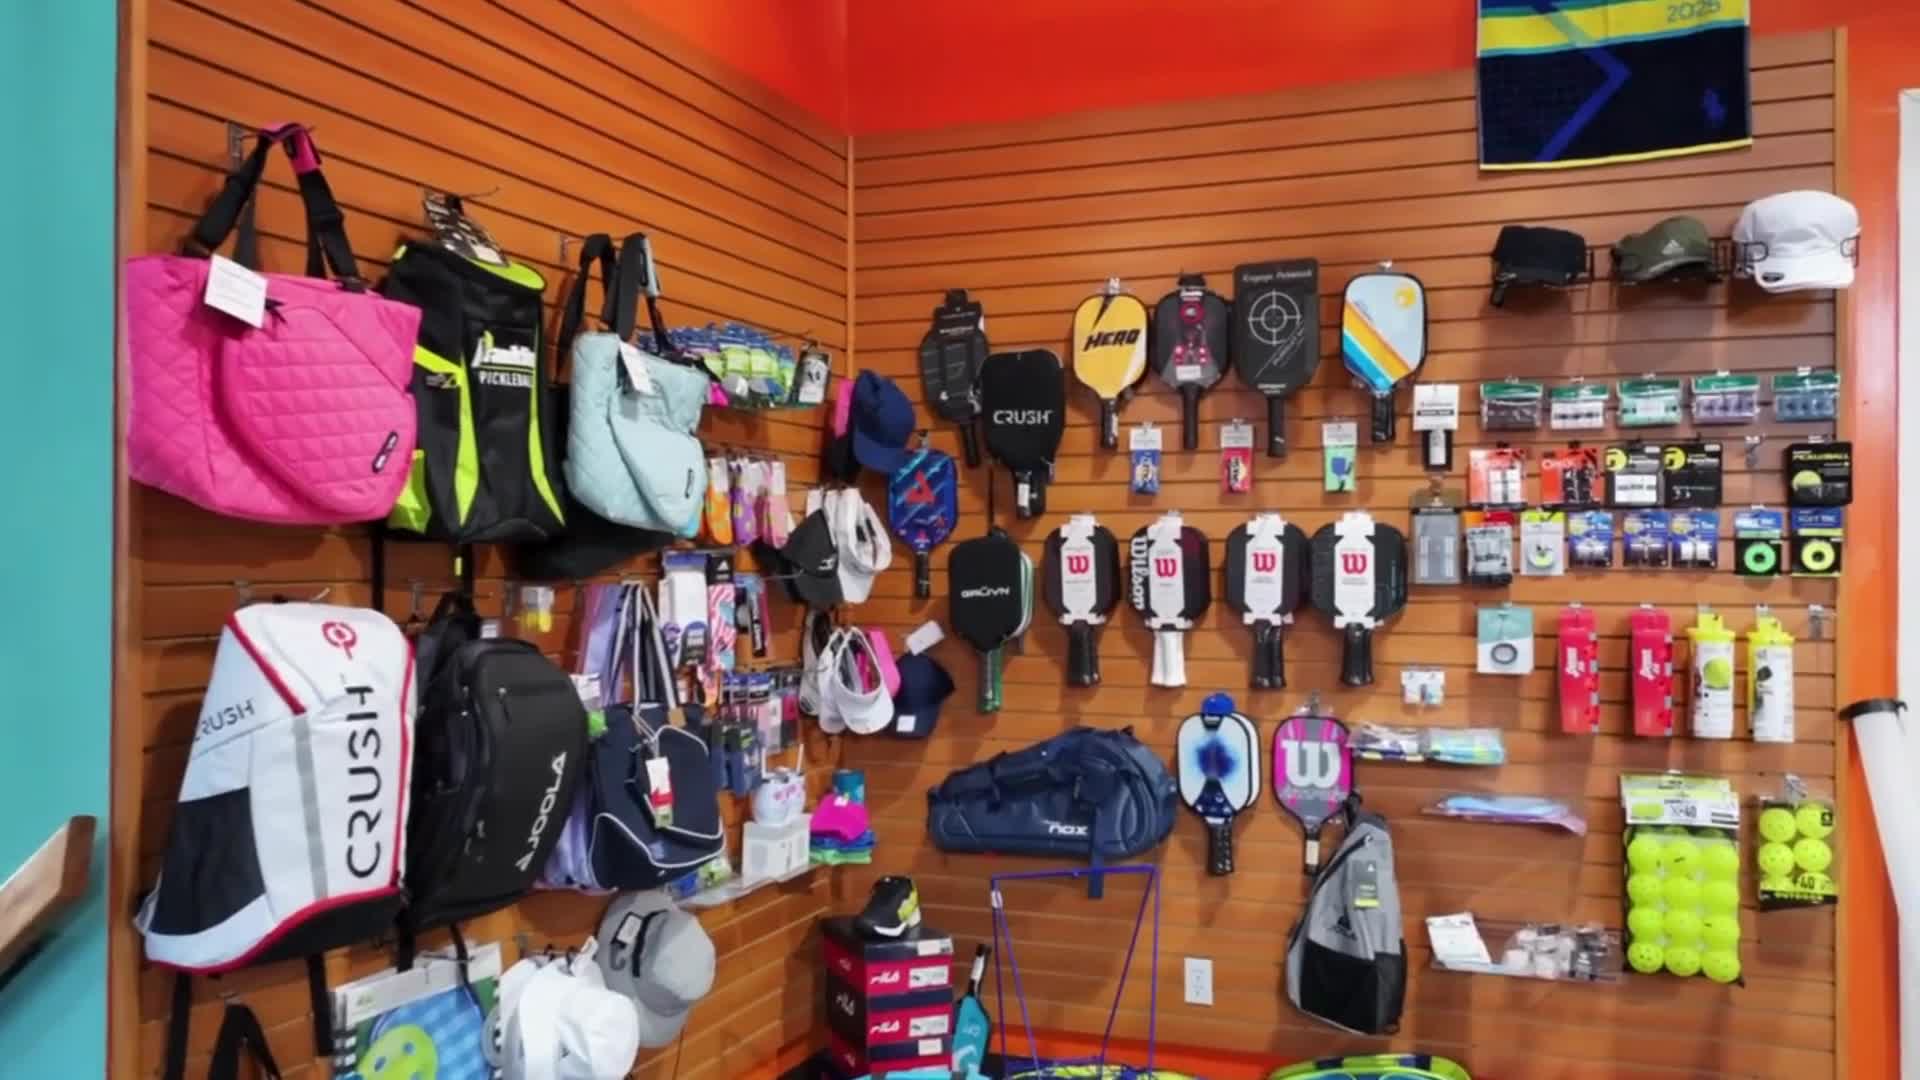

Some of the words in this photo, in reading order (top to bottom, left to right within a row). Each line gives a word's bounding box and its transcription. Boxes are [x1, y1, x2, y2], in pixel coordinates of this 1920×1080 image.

[1084, 328, 1140, 352] HERO
[993, 409, 1053, 425] CRUSH
[345, 685, 382, 878] CRUSH
[527, 751, 567, 850] JOOLA
[870, 971, 901, 985] FILA
[870, 1020, 901, 1035] FILA
